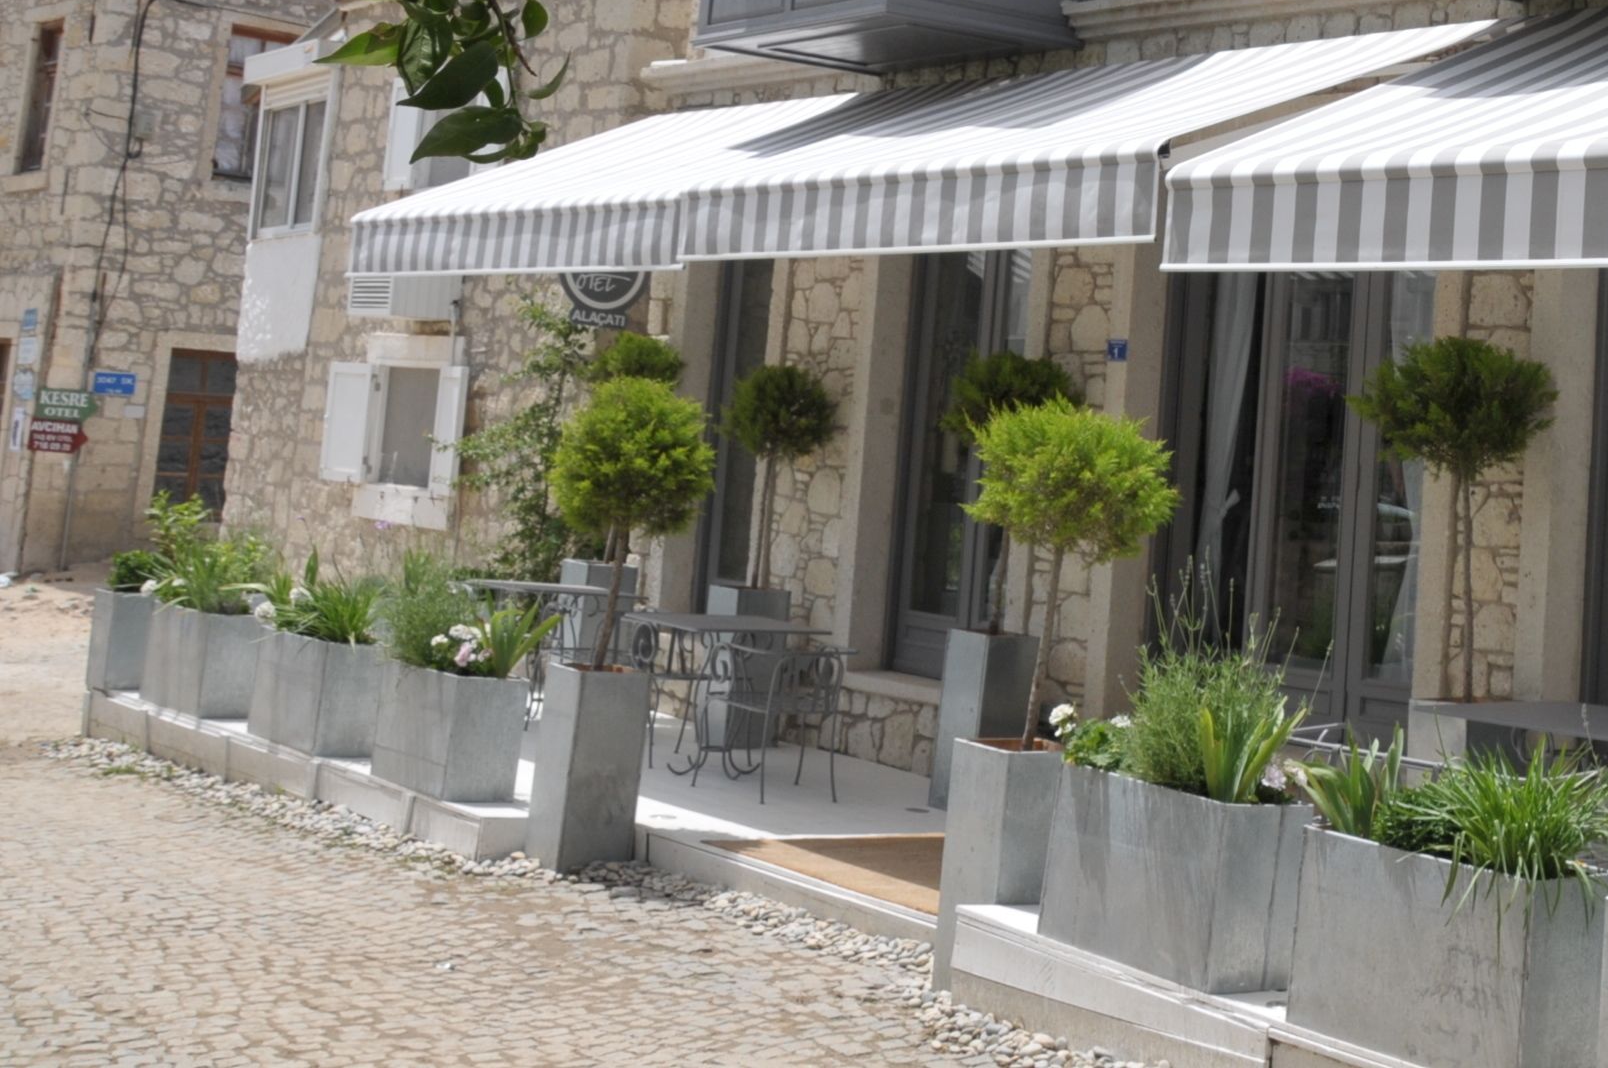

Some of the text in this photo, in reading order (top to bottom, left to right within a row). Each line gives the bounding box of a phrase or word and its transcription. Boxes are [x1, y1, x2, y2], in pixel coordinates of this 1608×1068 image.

[576, 274, 616, 292] OTEL
[572, 310, 625, 326] ALAÇATI
[40, 391, 88, 407] KESRE
[44, 407, 80, 418] OTEL
